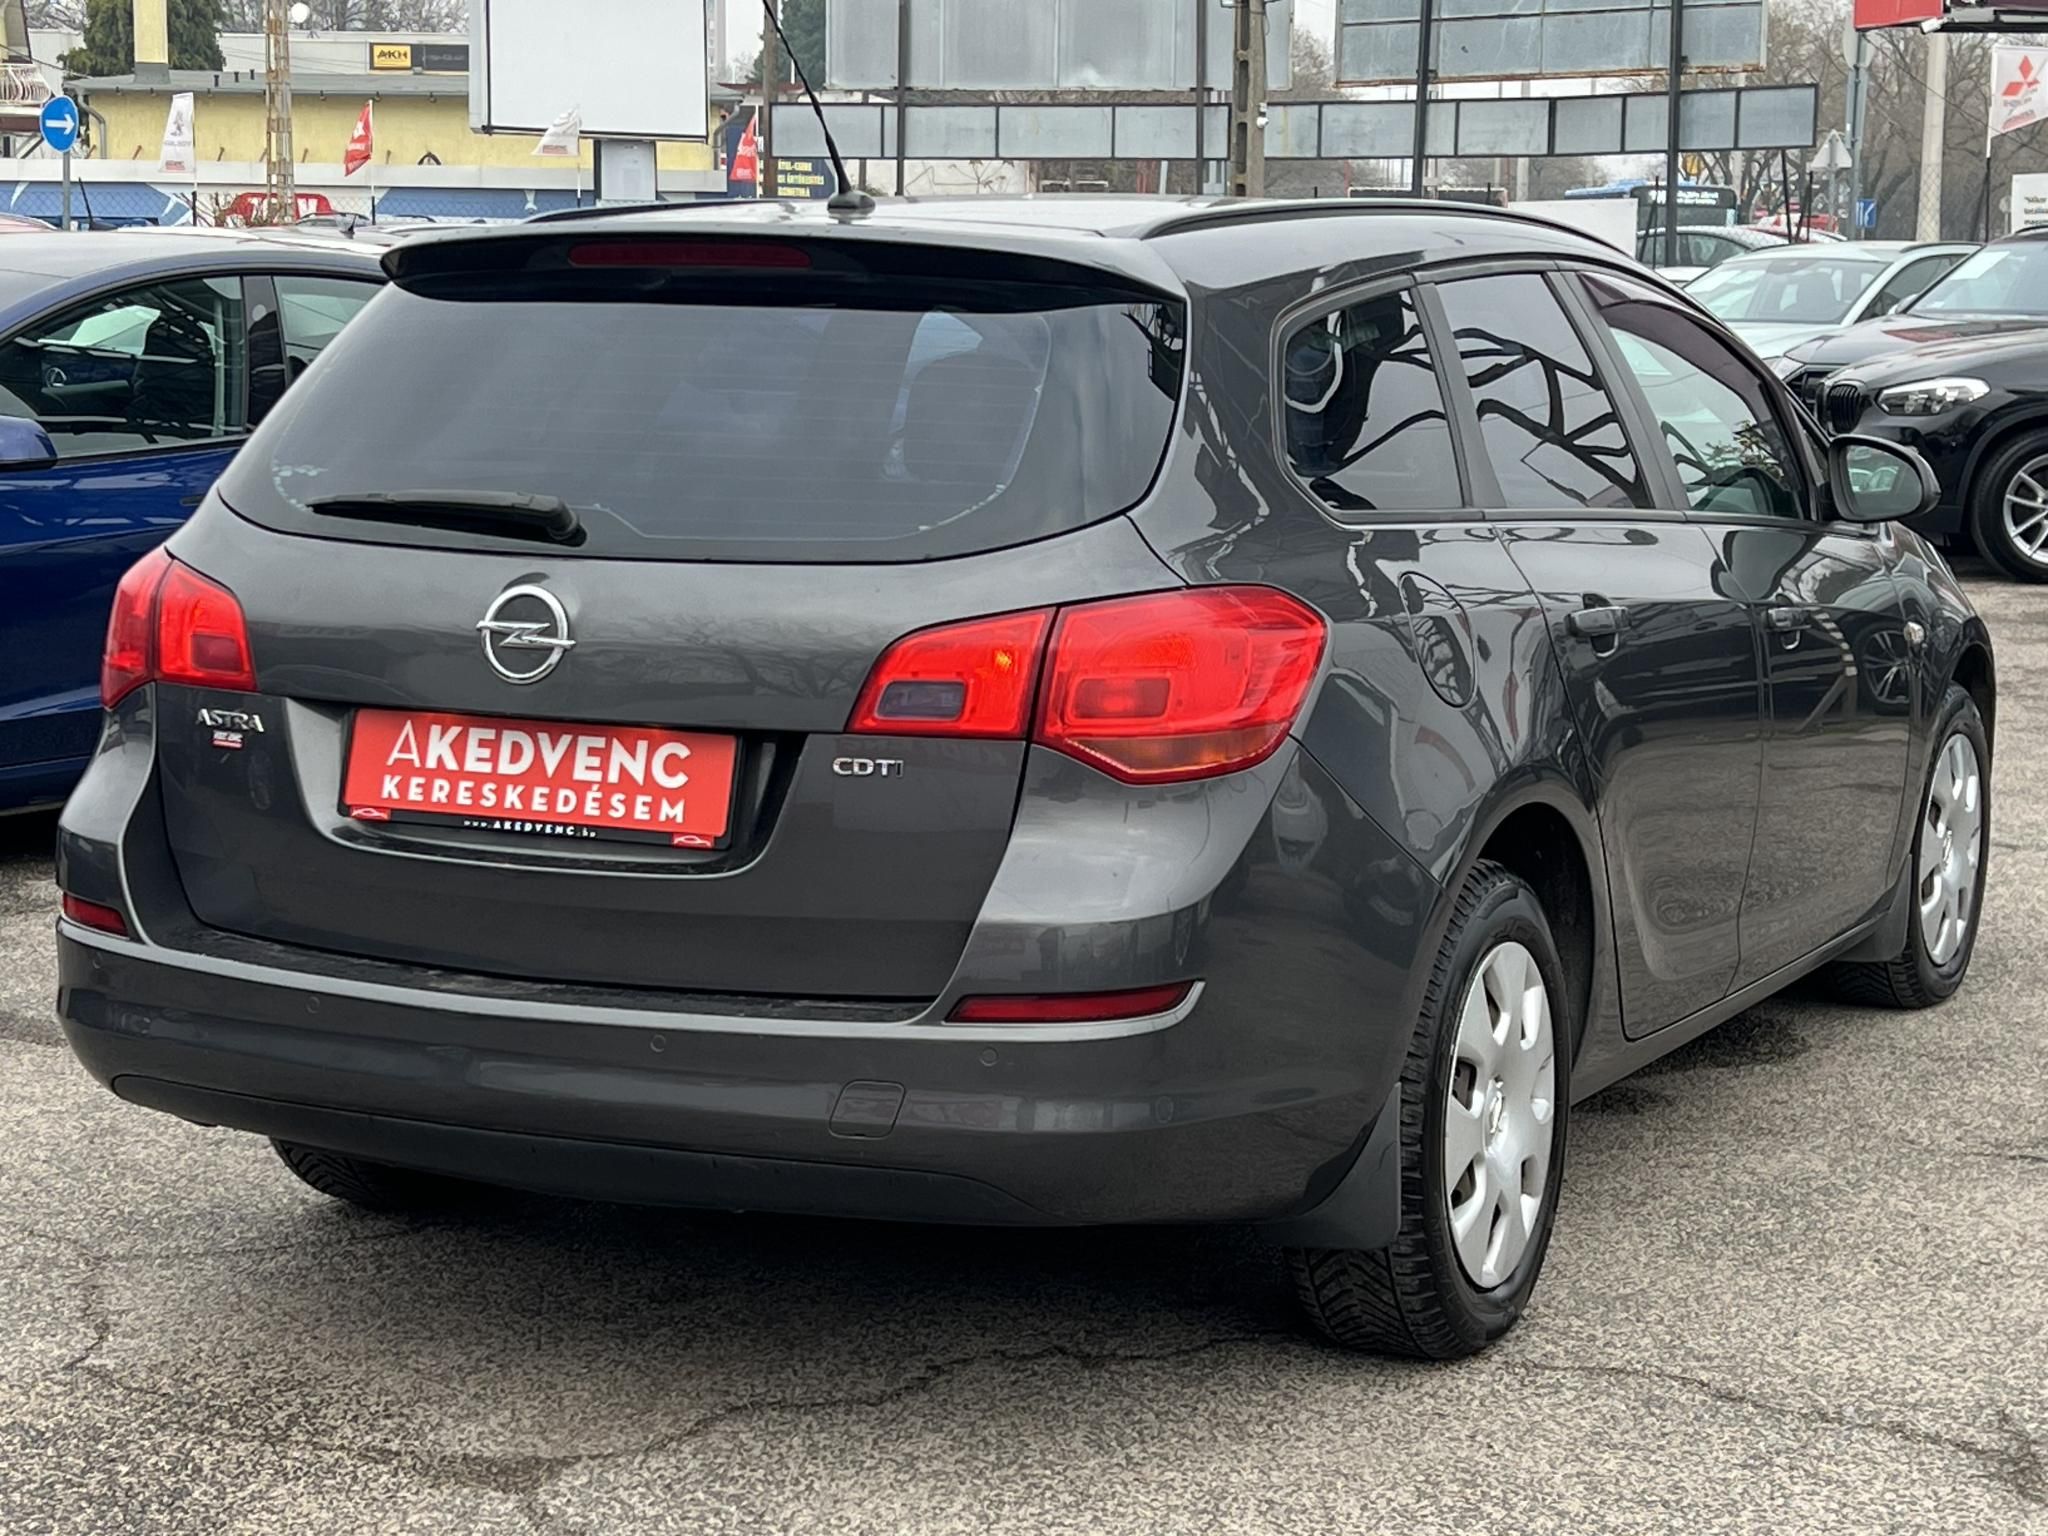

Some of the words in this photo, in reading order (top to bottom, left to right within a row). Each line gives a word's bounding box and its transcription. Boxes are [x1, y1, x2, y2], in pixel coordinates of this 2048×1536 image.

[195, 708, 265, 733] ASTRA
[832, 757, 904, 777] CDTI
[381, 774, 686, 824] KERESKEDÉSEM
